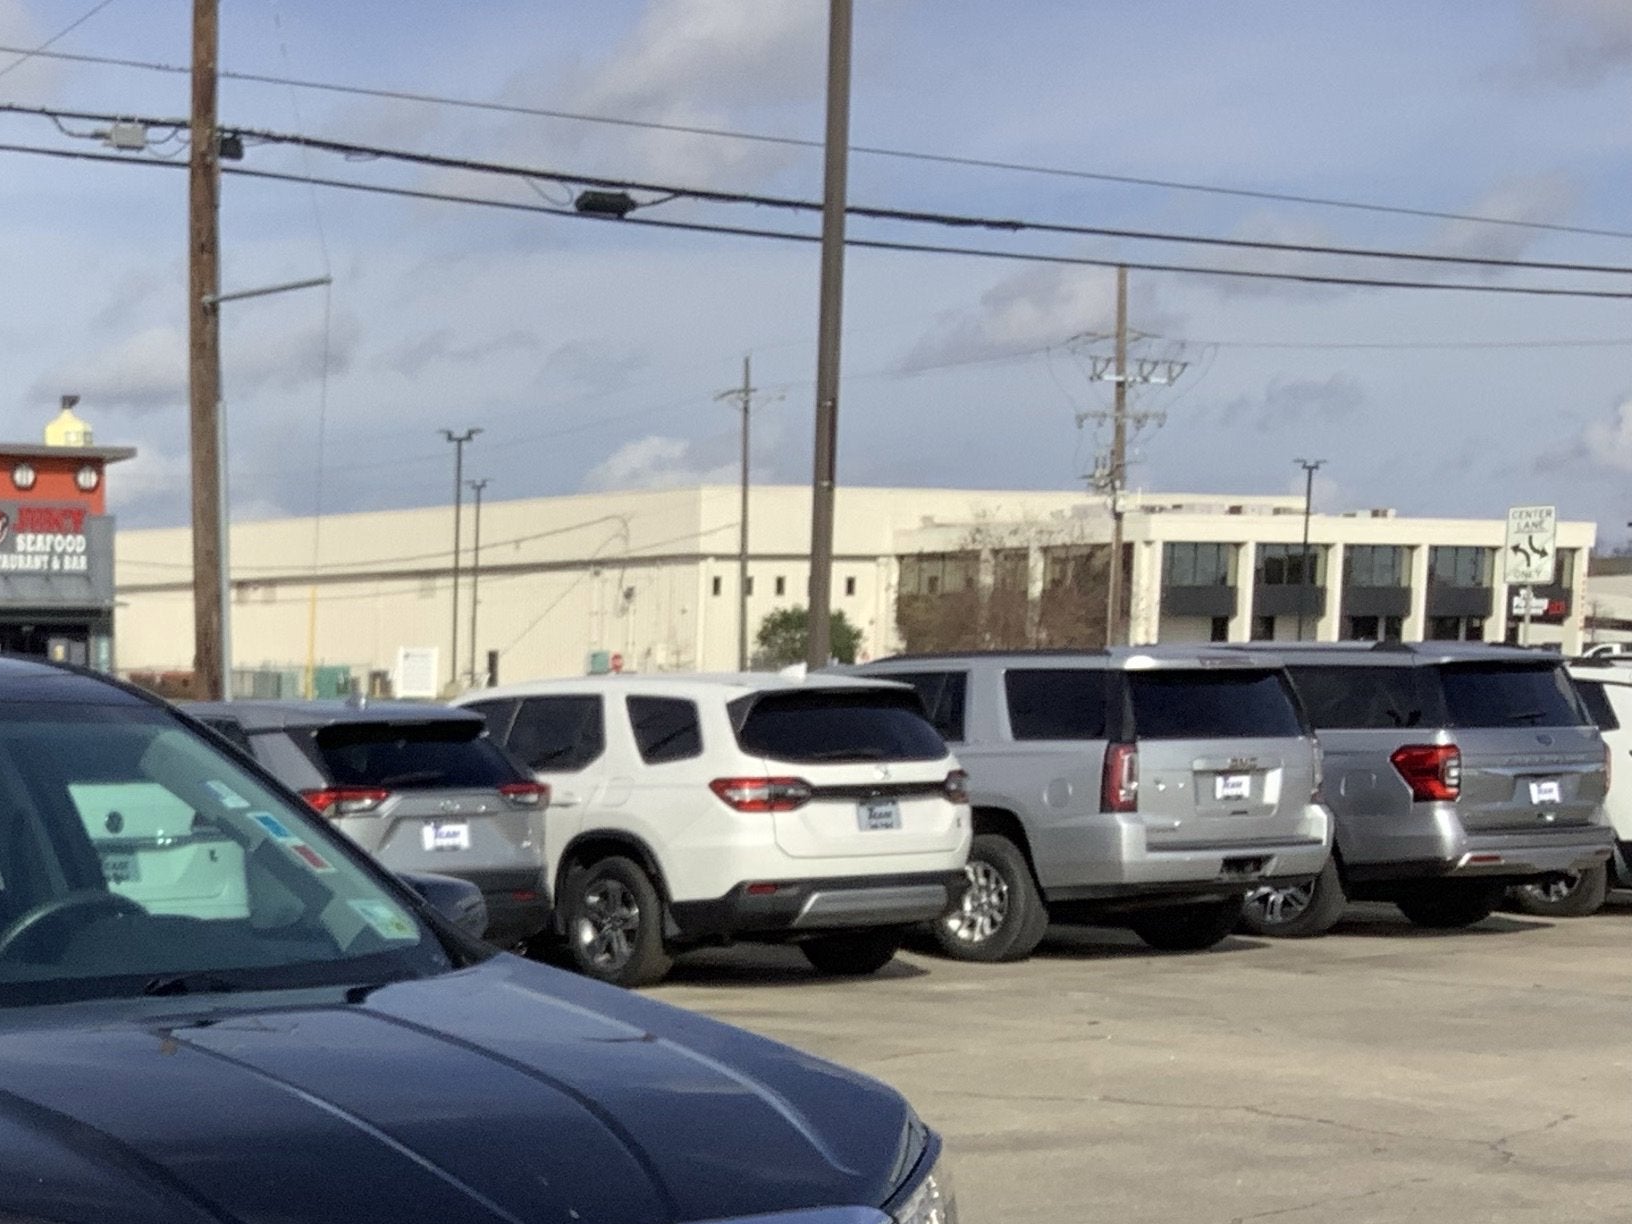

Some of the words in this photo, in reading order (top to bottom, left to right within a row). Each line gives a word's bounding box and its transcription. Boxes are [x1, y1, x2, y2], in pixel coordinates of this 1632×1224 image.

[1511, 509, 1552, 519] CENTER
[1517, 520, 1544, 530] LANE
[16, 533, 87, 553] SEAFOOD
[51, 555, 61, 571] &
